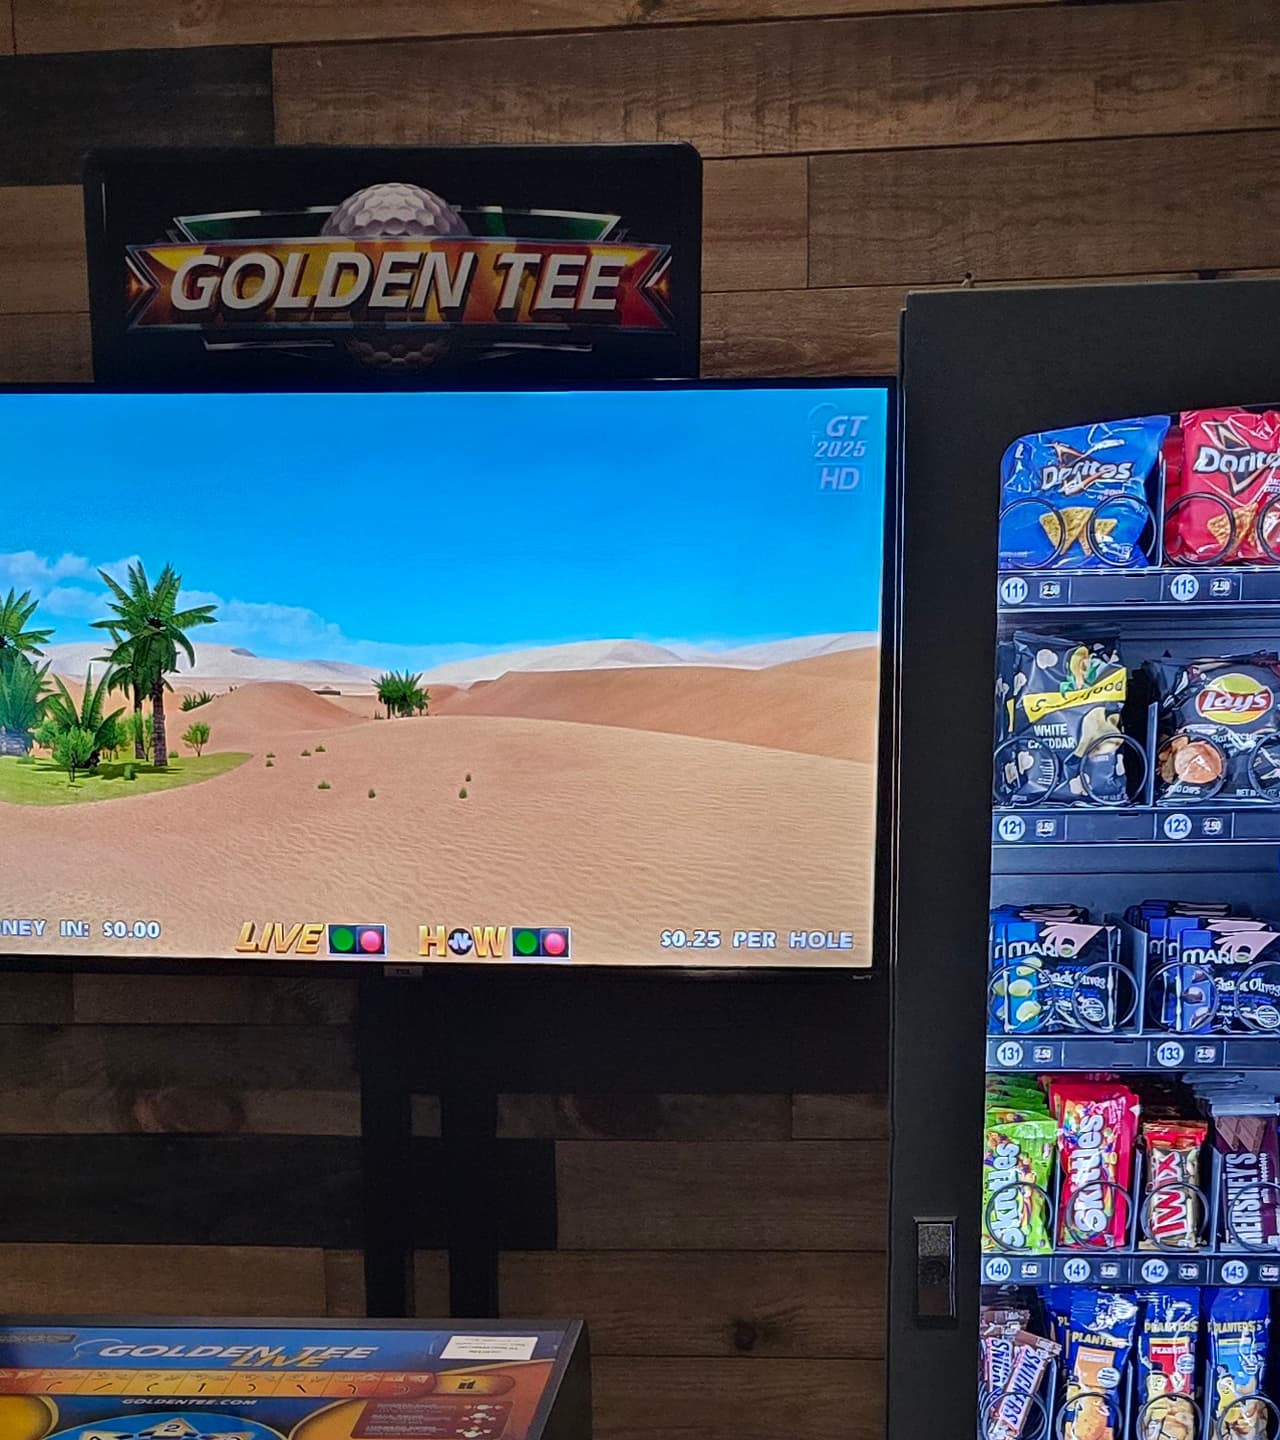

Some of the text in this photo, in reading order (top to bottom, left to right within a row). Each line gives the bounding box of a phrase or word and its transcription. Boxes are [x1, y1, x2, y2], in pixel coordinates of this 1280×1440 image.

[169, 250, 629, 312] GOLDEN TEE
[825, 415, 869, 438] GT
[814, 440, 869, 458] 2025
[819, 466, 860, 491] HD
[1004, 582, 1026, 597] 111
[1174, 580, 1196, 594] 113
[1033, 723, 1068, 737] WHITE
[1002, 820, 1023, 835] 121
[1166, 819, 1189, 833] 123
[60, 920, 90, 938] IN:
[102, 920, 161, 939] $0.00
[235, 921, 325, 954] LIVE
[660, 929, 854, 950] $0.25 PER HOLE
[999, 1046, 1022, 1062] 131
[1159, 1046, 1182, 1062] 133
[1074, 1113, 1109, 1233] Skittles
[1150, 1151, 1190, 1239] TWIX
[988, 1262, 1010, 1277] 140
[1066, 1263, 1088, 1277] 141
[1144, 1263, 1166, 1278] 142
[1223, 1264, 1245, 1279] 143
[98, 1344, 283, 1359] GOLDEN
[230, 1352, 331, 1368] LIVE
[1004, 1348, 1041, 1425] SNICKERS
[163, 1423, 181, 1433] 2
